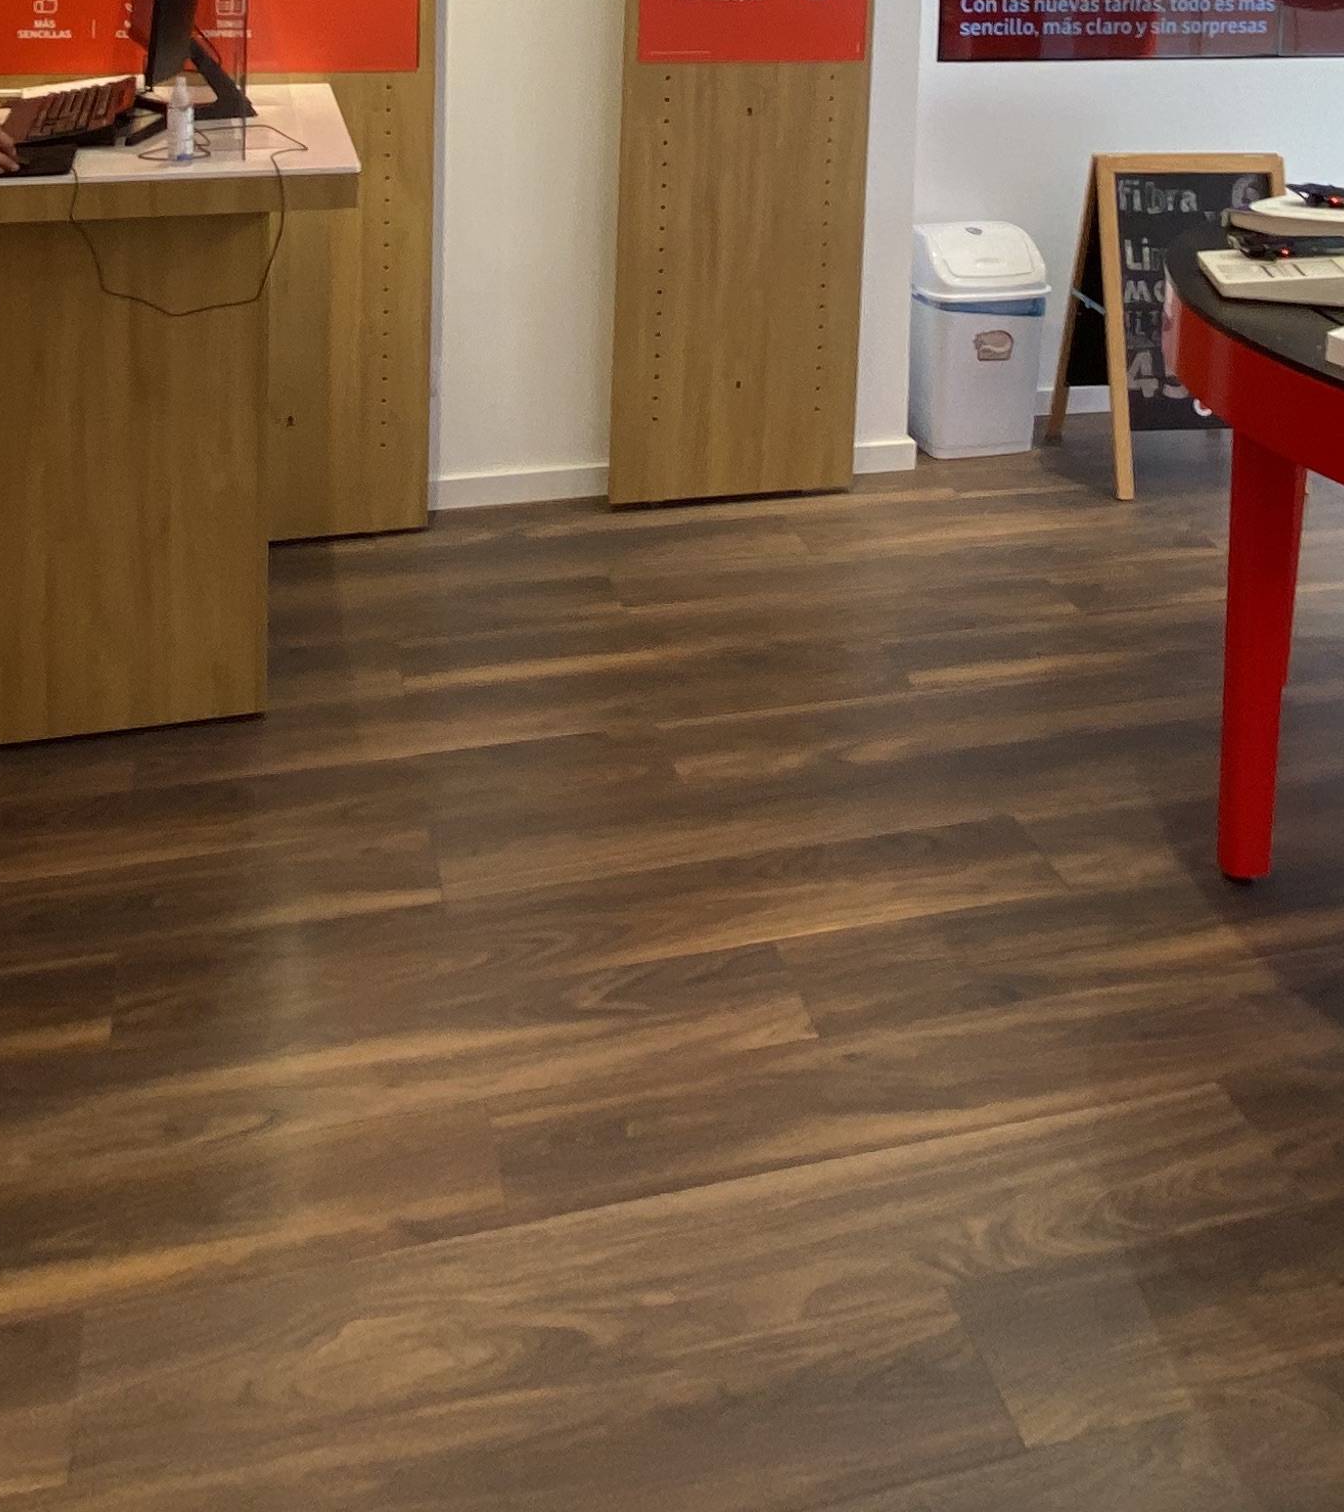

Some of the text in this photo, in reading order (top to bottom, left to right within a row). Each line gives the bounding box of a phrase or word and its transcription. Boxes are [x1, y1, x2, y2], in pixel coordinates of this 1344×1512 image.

[959, 17, 1268, 38] sencillo, más claro y sin sorpresas
[1119, 178, 1199, 214] Fibra
